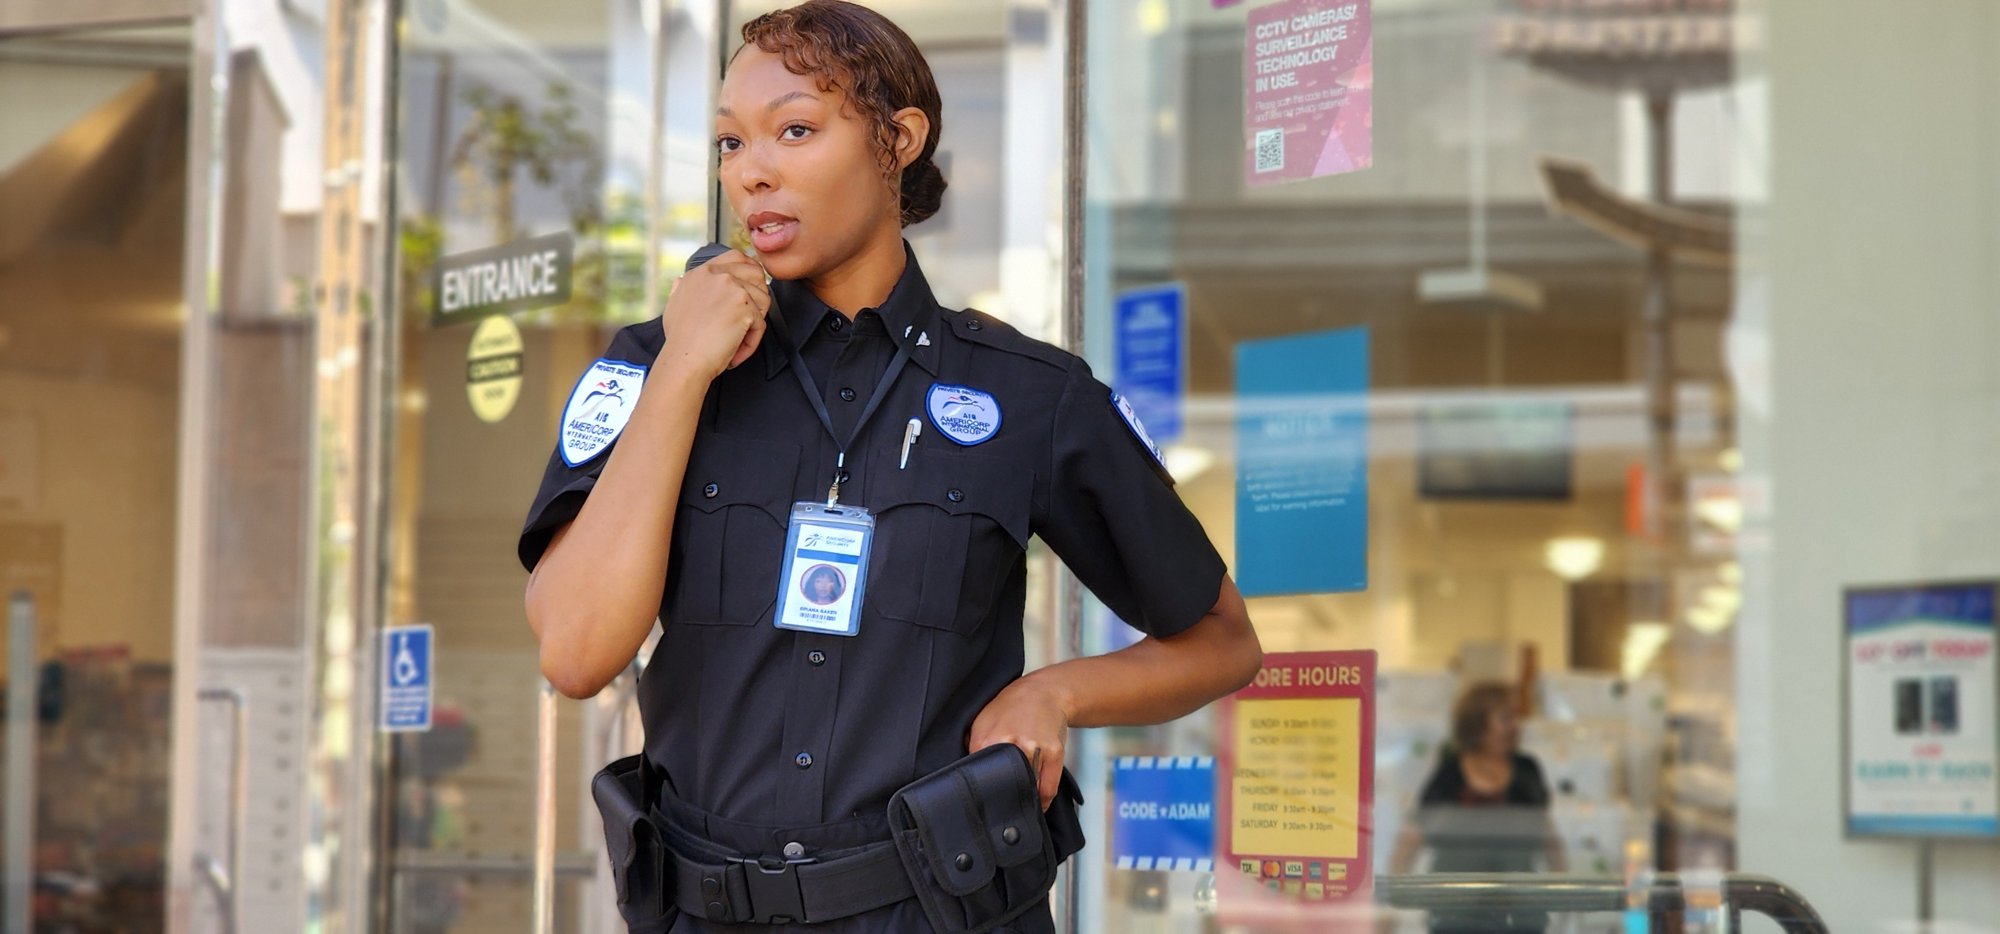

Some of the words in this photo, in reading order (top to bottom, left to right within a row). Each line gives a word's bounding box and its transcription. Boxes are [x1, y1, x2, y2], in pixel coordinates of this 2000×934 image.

[1256, 19, 1290, 39] CCTV
[1291, 4, 1358, 31] CAMERAS/
[1256, 25, 1348, 57] SURVEILLANCE
[1255, 45, 1338, 74] TECHNOLOGY
[1256, 78, 1268, 92] IN
[1271, 72, 1299, 90] USE.
[441, 250, 558, 314] ENTRANCE
[616, 368, 642, 379] SECURITY
[568, 419, 615, 437] AMERICORP
[940, 415, 991, 428] AMERICORP
[941, 421, 990, 433] INTERNATIONAL
[949, 427, 982, 436] GROUP
[568, 439, 597, 452] GROUP
[1249, 668, 1292, 687] ORE
[1299, 666, 1361, 686] HOURS
[1120, 801, 1158, 819] CODE
[1168, 802, 1210, 819] ADAM
[1253, 802, 1278, 812] FRIDAY
[1241, 818, 1278, 829] SATURDAY
[1287, 864, 1302, 873] VISA
